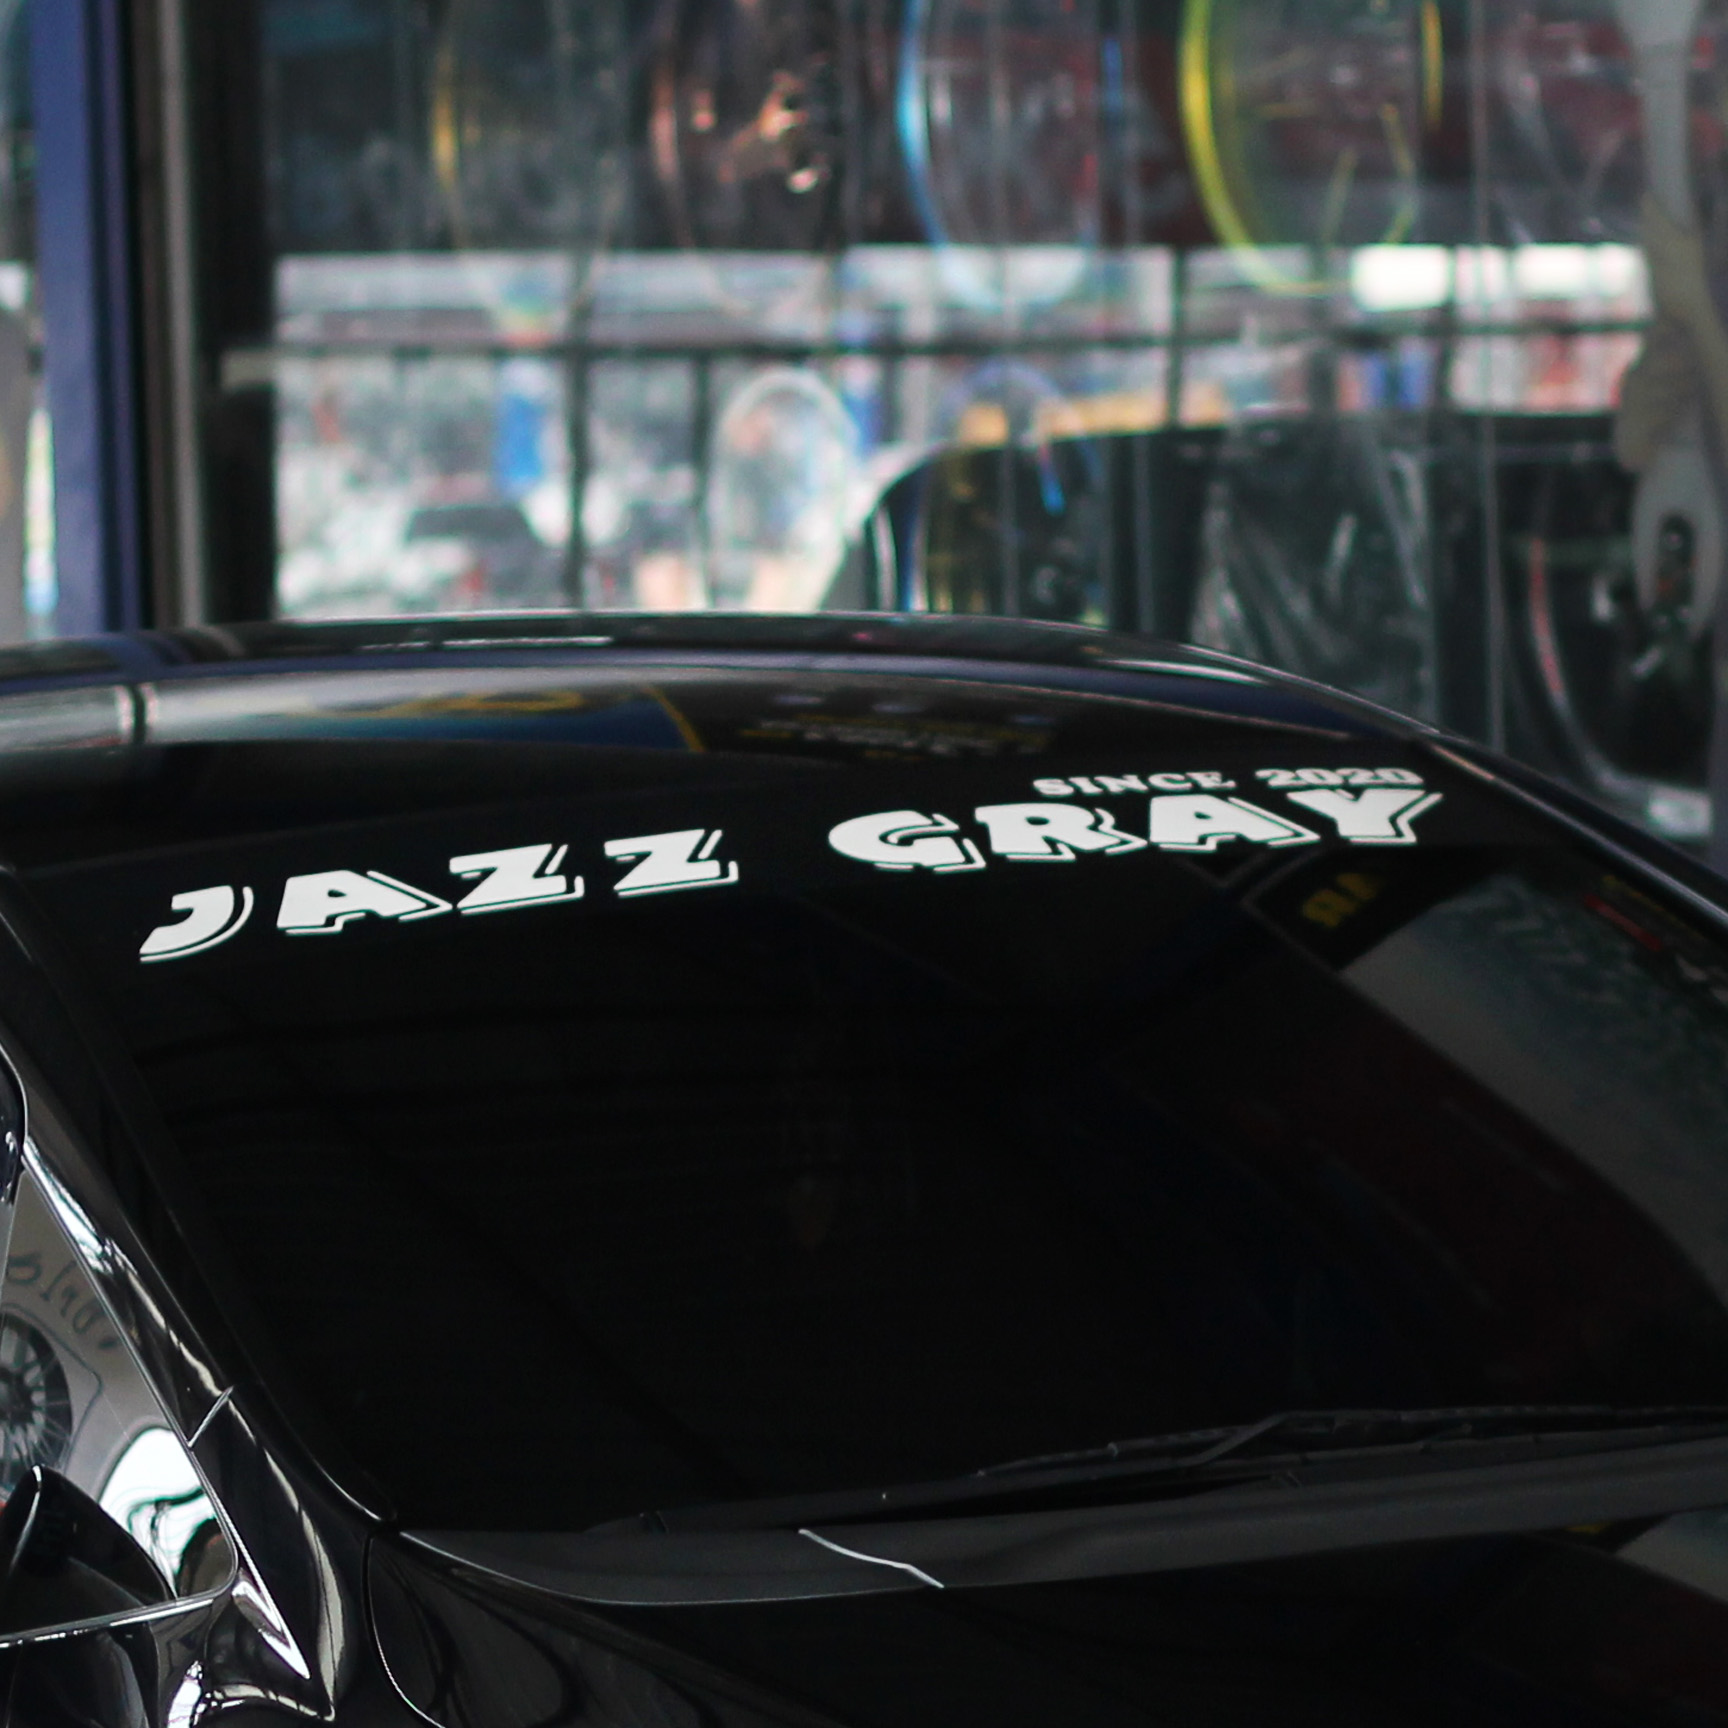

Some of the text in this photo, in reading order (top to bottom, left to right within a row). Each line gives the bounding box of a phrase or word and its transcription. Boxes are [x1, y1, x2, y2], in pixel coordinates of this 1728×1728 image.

[1033, 768, 1424, 797] SINCE 2020
[139, 788, 1442, 962] JAZZ GRAY
